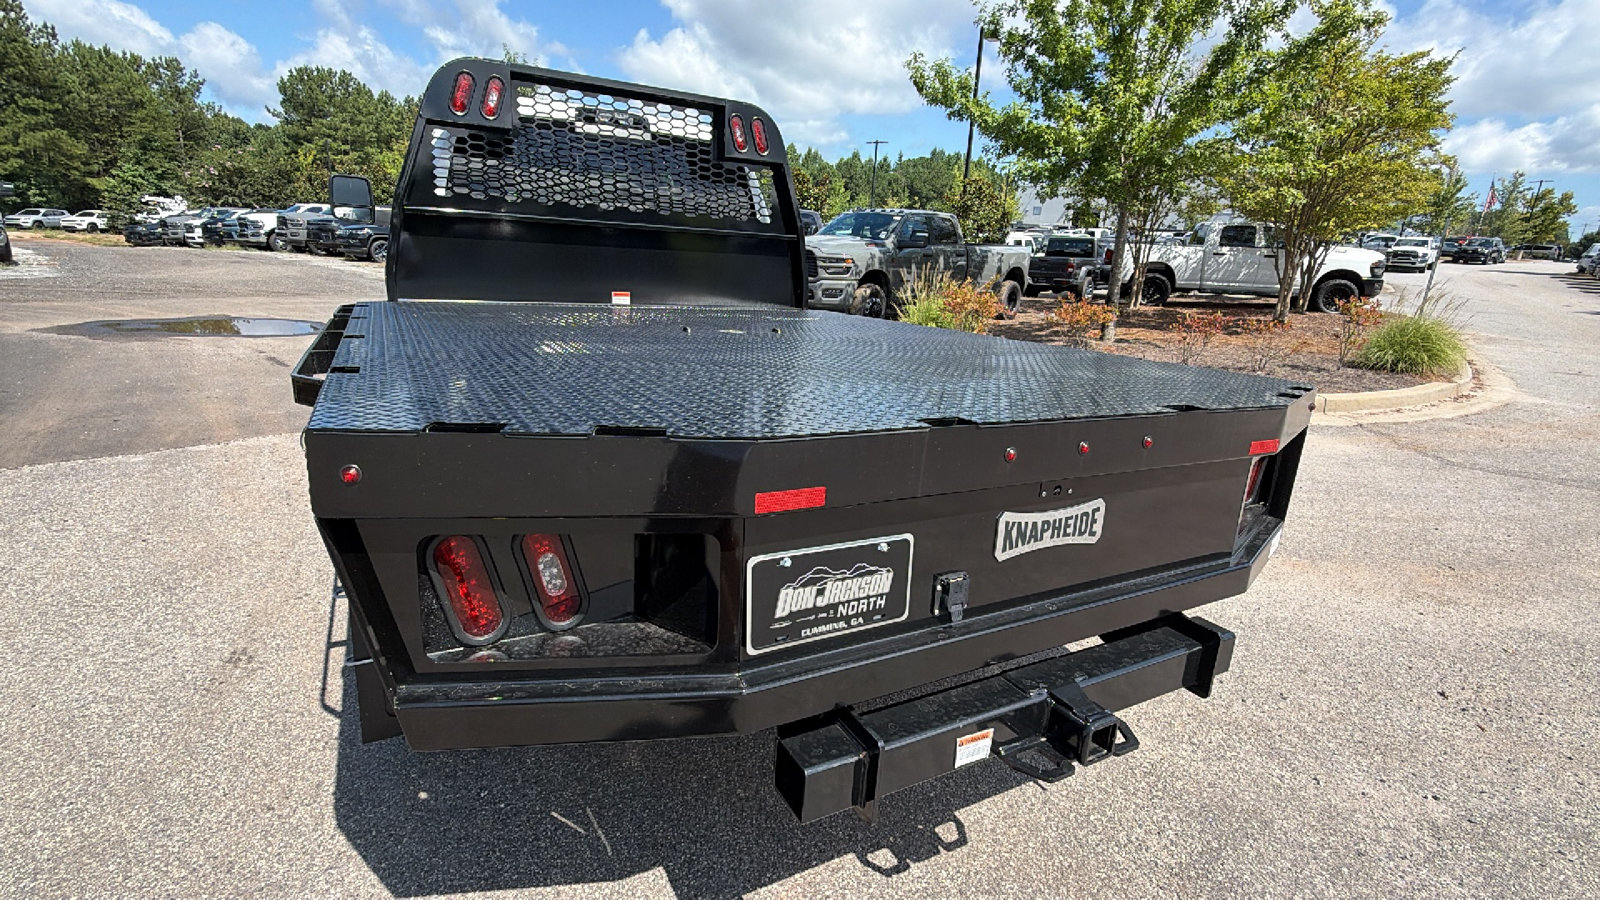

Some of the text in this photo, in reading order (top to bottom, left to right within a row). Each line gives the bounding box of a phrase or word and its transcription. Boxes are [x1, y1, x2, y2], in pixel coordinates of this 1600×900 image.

[1001, 506, 1101, 554] KNAPHEIDE
[774, 572, 894, 618] DON JACKSON
[837, 595, 887, 617] NORTH
[851, 616, 864, 626] GA
